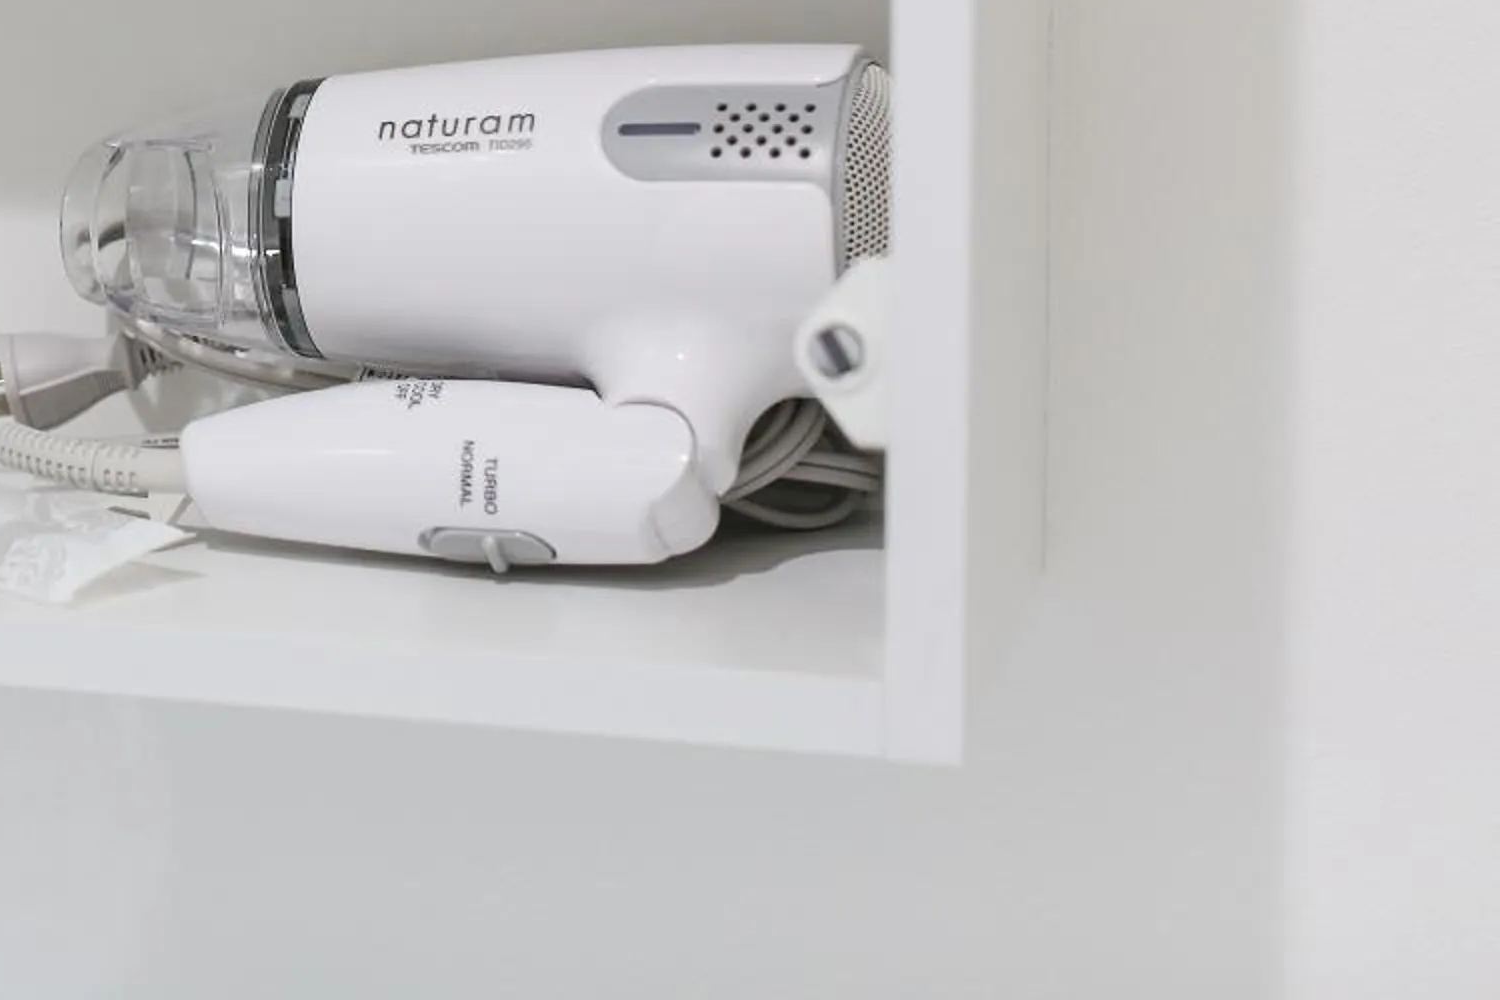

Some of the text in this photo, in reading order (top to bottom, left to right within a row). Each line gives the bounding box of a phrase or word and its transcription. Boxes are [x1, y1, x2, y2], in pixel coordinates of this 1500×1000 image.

[378, 112, 535, 140] naturam
[409, 141, 479, 155] TESCOM
[460, 440, 476, 507] NORMAL
[484, 457, 498, 515] TURBO
